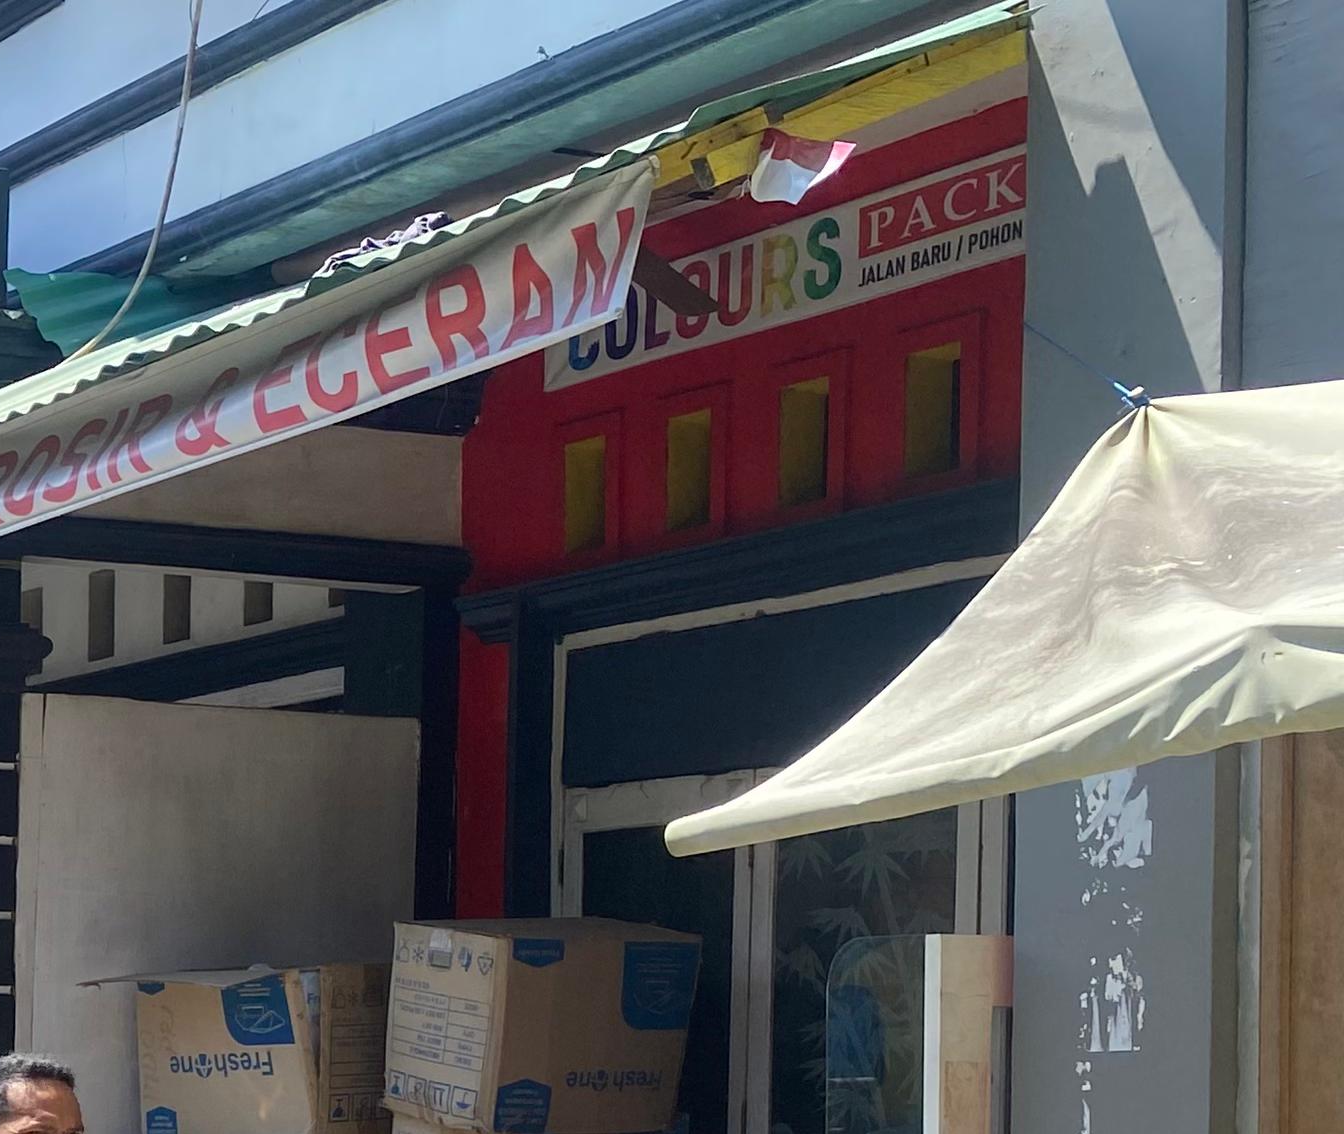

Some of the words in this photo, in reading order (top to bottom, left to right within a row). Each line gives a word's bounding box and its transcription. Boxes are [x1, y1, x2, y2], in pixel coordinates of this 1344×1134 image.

[867, 162, 1024, 249] PACK
[858, 255, 906, 287] JALAN
[911, 241, 951, 271] BARU
[968, 219, 1023, 255] POHON
[174, 366, 245, 460] &
[252, 205, 637, 434] ECERAN
